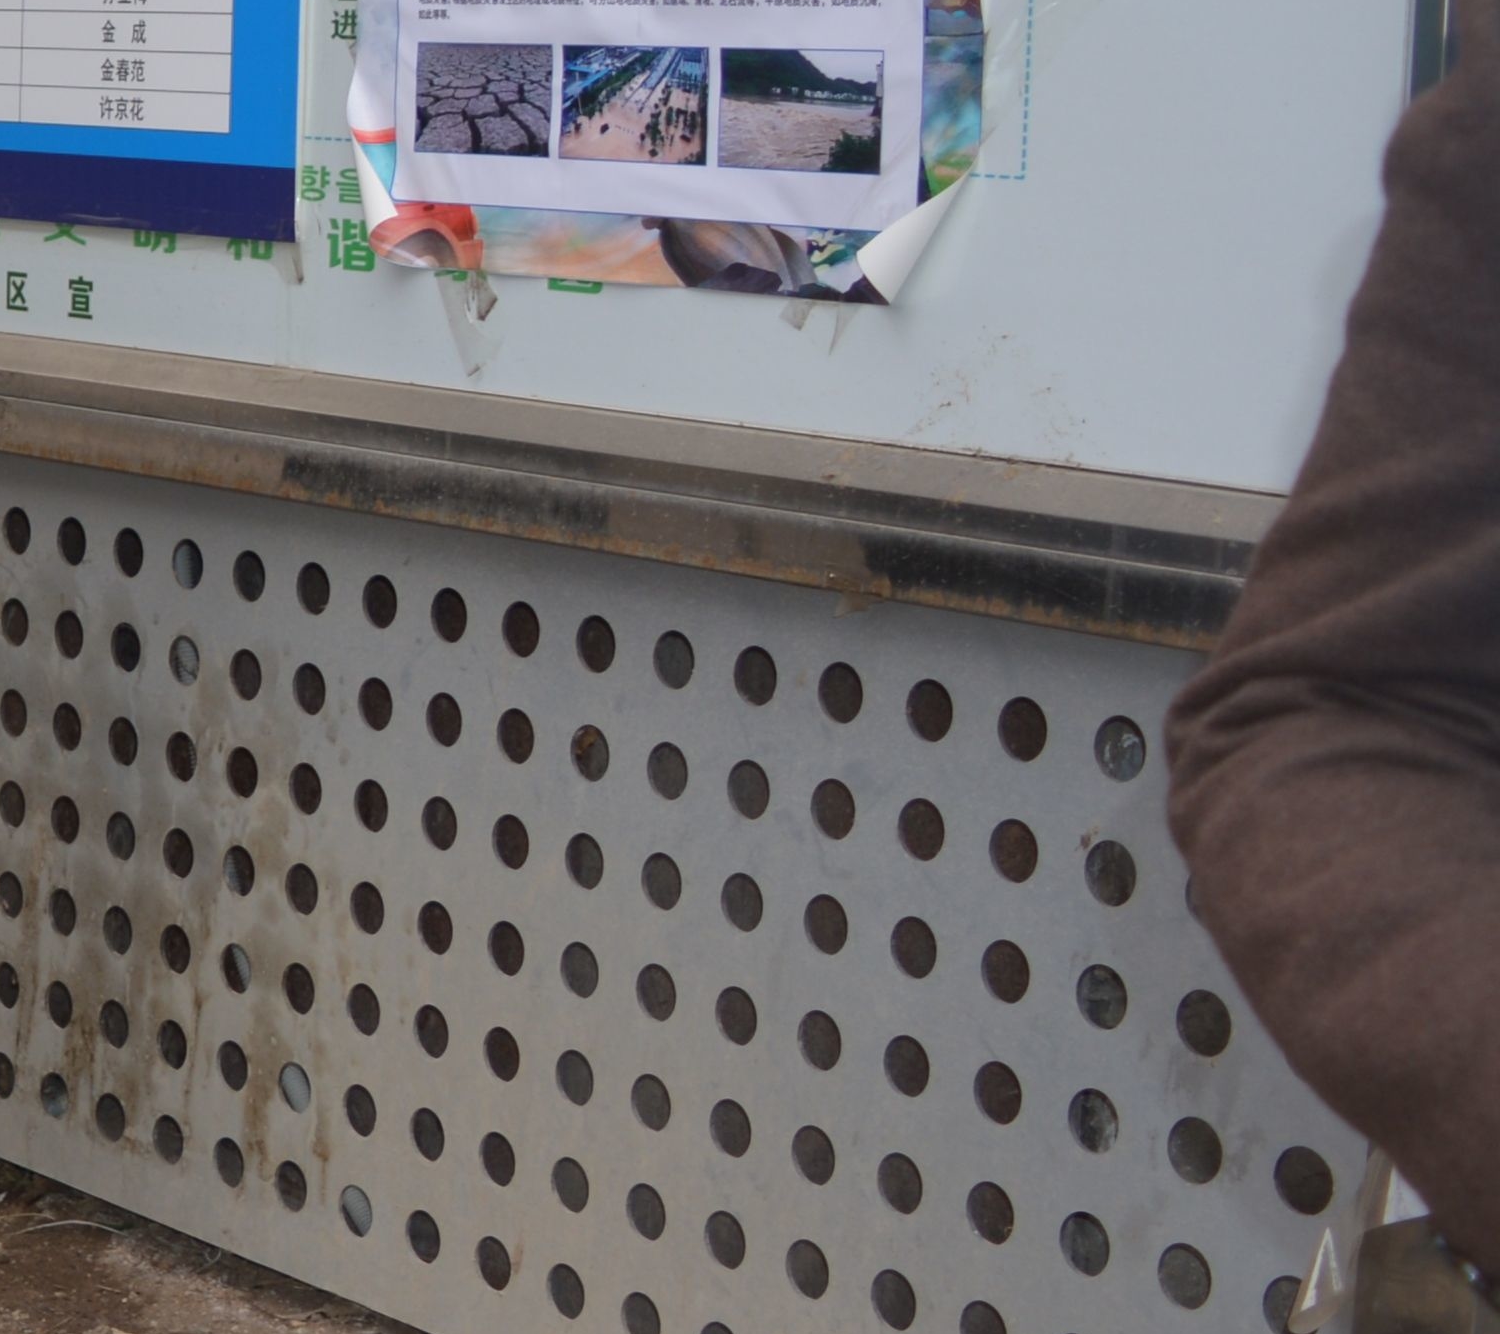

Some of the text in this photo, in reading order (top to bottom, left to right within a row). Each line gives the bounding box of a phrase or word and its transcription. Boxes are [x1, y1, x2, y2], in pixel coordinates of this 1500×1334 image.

[331, 9, 357, 40] 进
[100, 57, 146, 83] 金春范
[98, 96, 145, 121] 许京花
[66, 275, 95, 320] 宣
